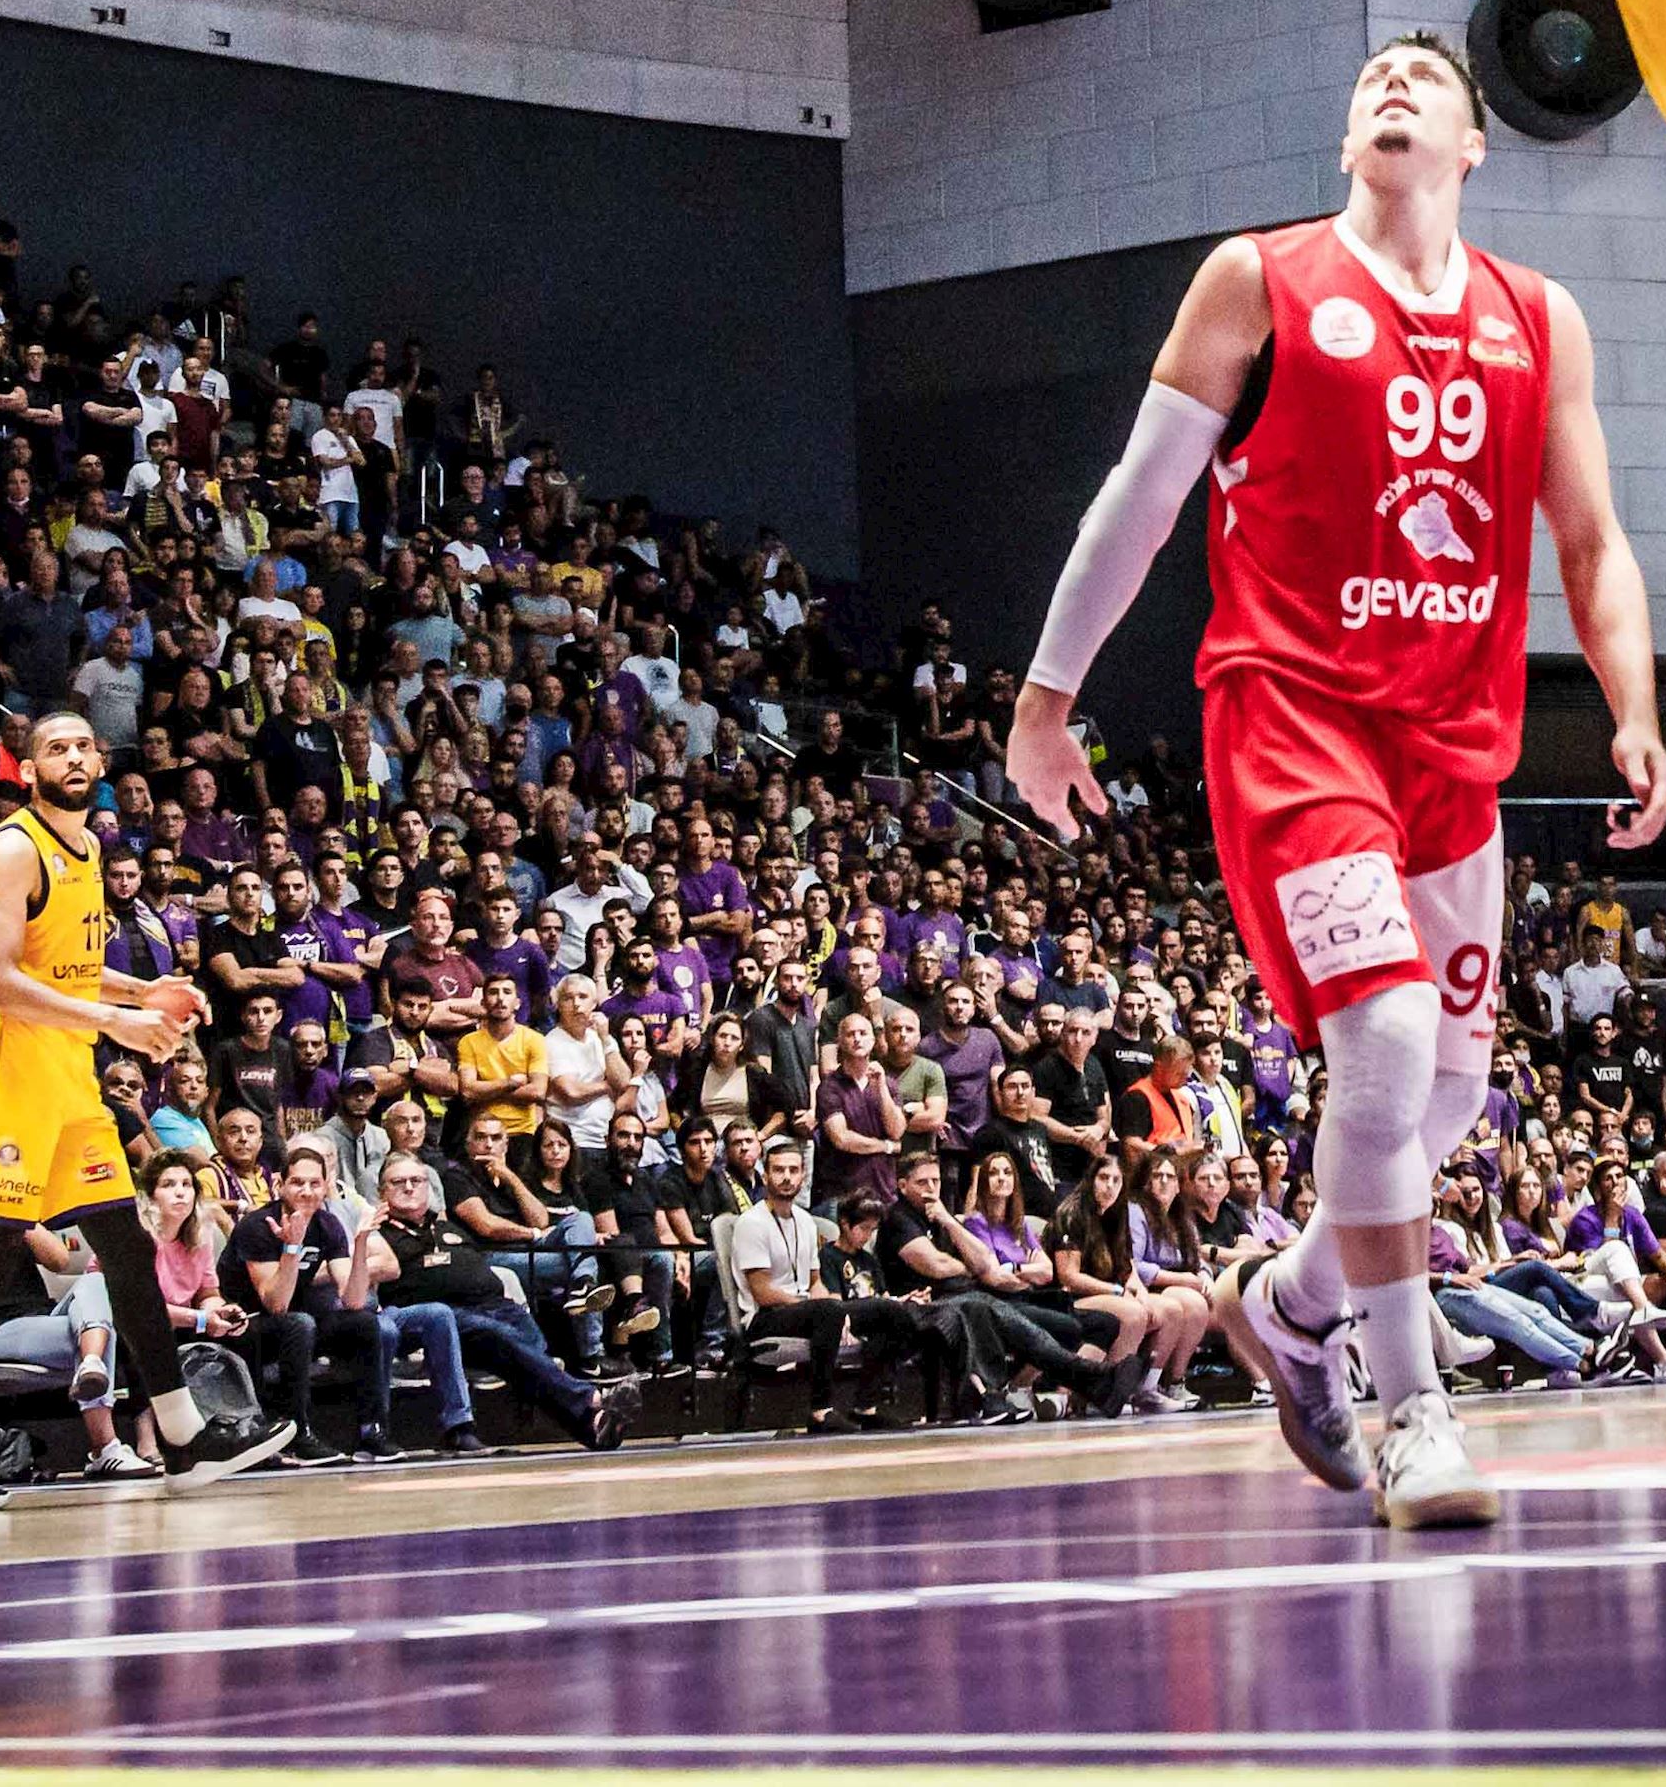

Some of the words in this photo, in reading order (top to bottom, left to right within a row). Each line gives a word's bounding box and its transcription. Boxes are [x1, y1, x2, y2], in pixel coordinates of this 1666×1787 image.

[1385, 374, 1488, 463] 99
[82, 910, 102, 952] 11
[1591, 1066, 1623, 1083] VANS
